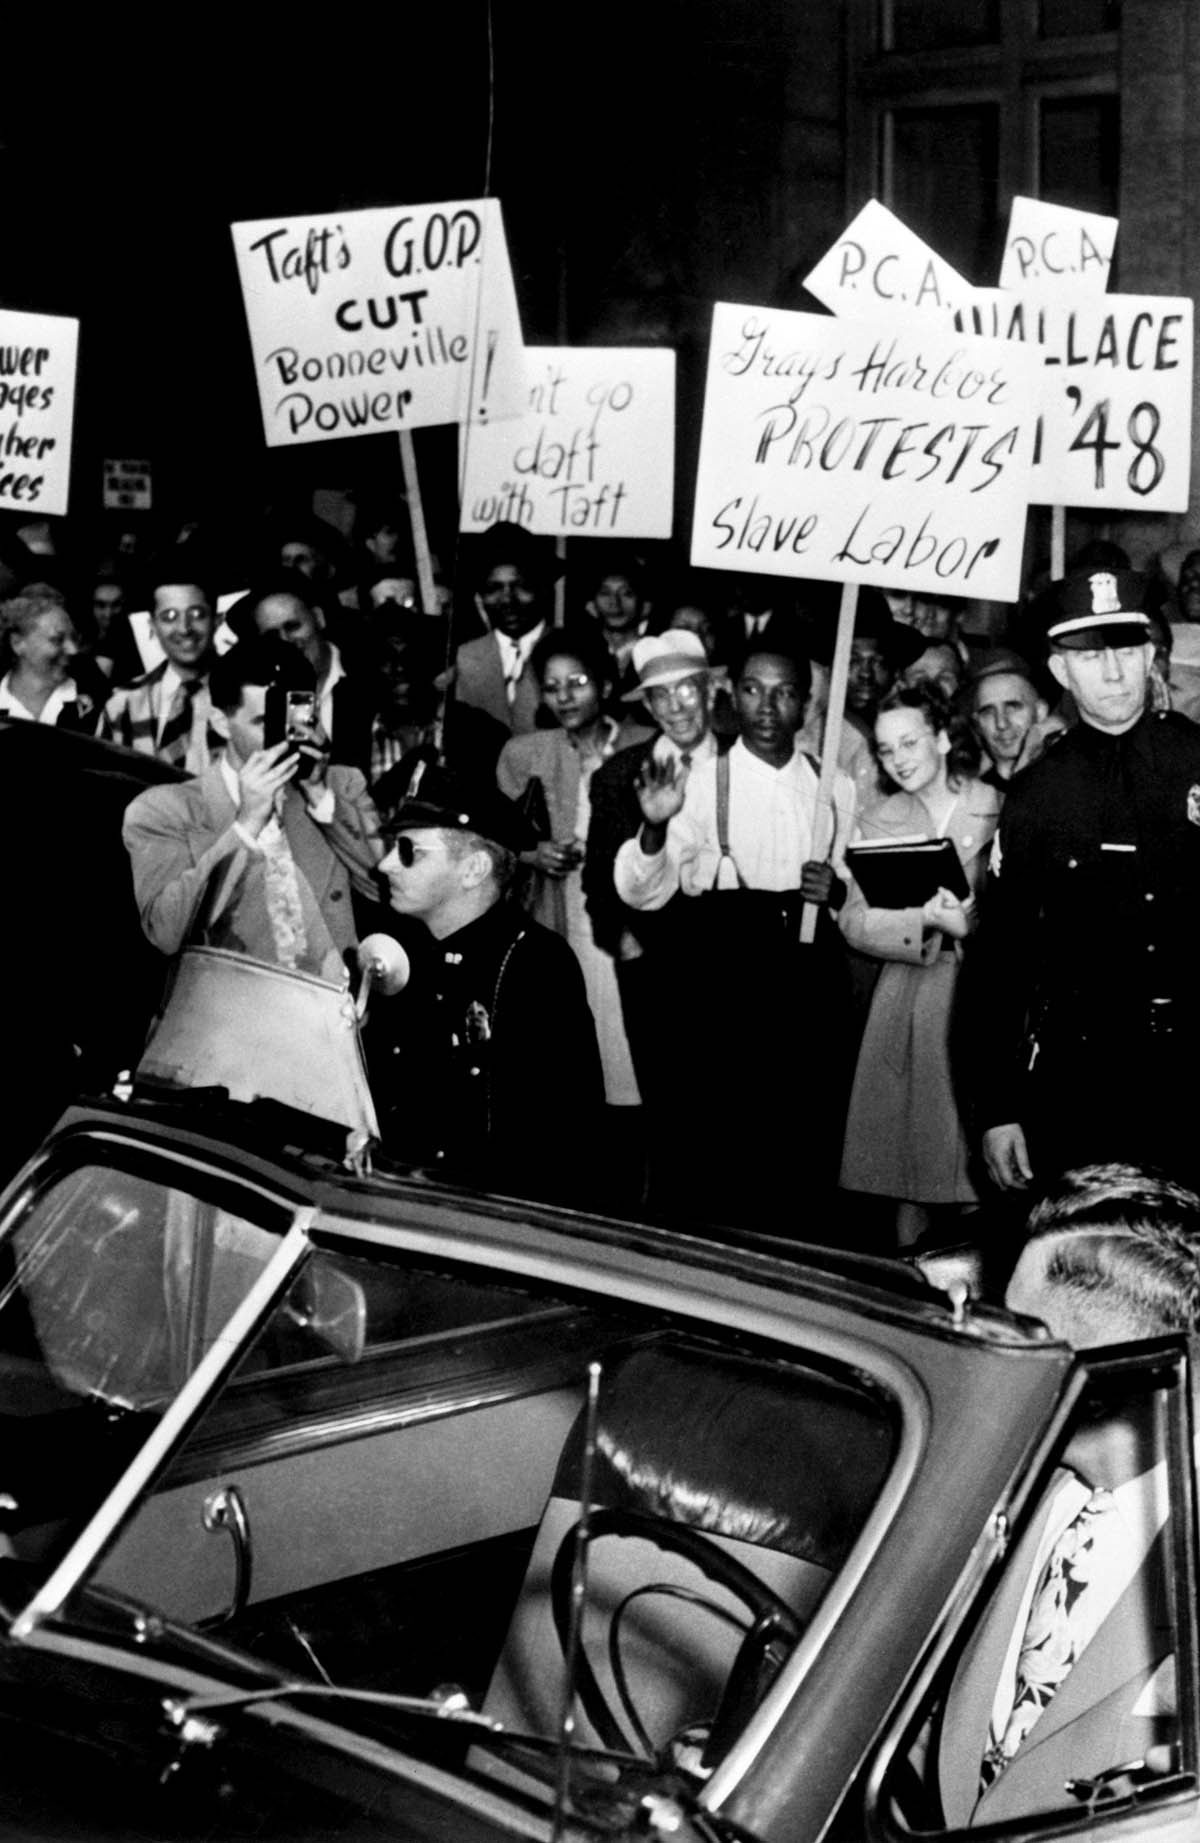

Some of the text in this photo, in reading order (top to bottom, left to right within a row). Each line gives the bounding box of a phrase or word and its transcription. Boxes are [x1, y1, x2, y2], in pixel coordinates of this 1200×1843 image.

[249, 210, 481, 295] Taft's G.O.P.
[838, 241, 953, 308] P.C.A.
[335, 289, 429, 333] CUT
[0, 346, 50, 377] wer
[264, 325, 469, 386] Bonneville
[721, 316, 1009, 405] Grays Harbor
[275, 389, 414, 435] Power
[529, 364, 633, 440] n't go
[0, 421, 56, 461] her
[513, 425, 600, 482] daft
[755, 403, 1020, 494] PROTESTS
[1065, 384, 1166, 497] '48
[0, 470, 44, 502] ces
[472, 481, 628, 528] with Taft
[711, 494, 1002, 580] Slave Labor
